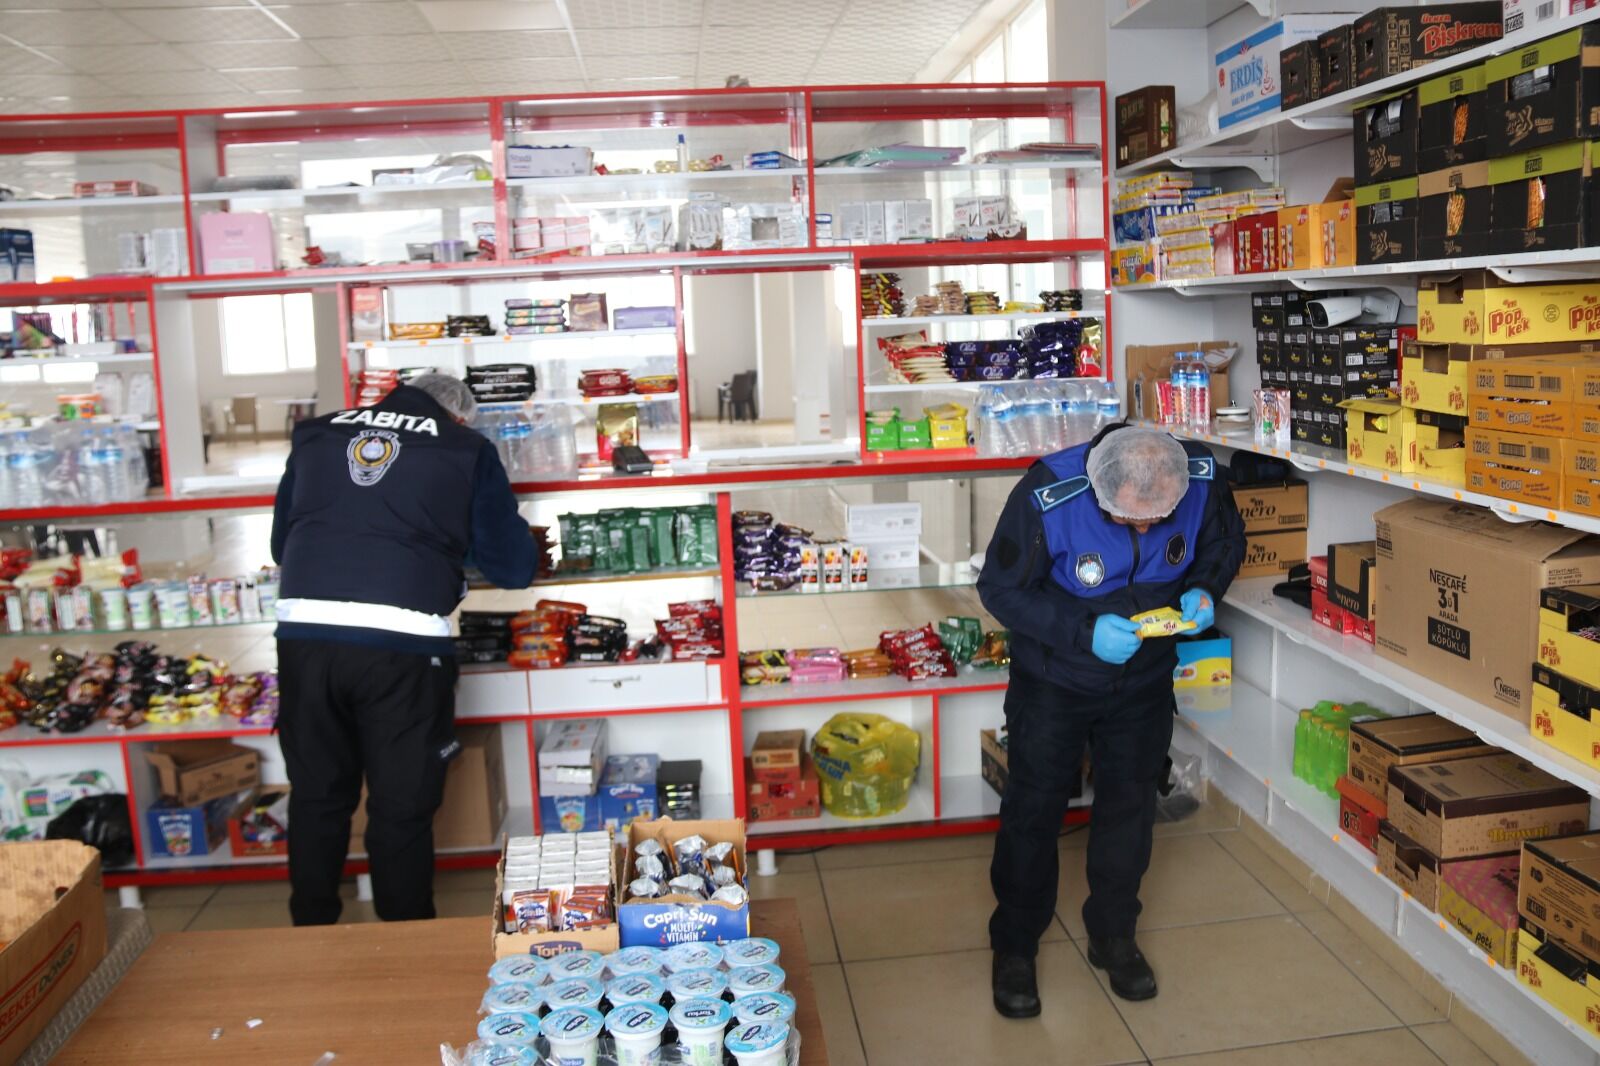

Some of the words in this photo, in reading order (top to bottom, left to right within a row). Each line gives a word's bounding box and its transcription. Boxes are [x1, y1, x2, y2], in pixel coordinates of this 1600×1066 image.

[1420, 21, 1503, 54] Biskrem
[330, 410, 439, 436] ZABITA
[1506, 410, 1532, 425] Gong
[1500, 479, 1523, 491] Gong
[1429, 568, 1468, 593] NESCAFÉ
[1439, 610, 1459, 623] ARADA
[1437, 624, 1461, 641] SÜTLÜ
[1431, 633, 1467, 654] KÖPÜKLÜ
